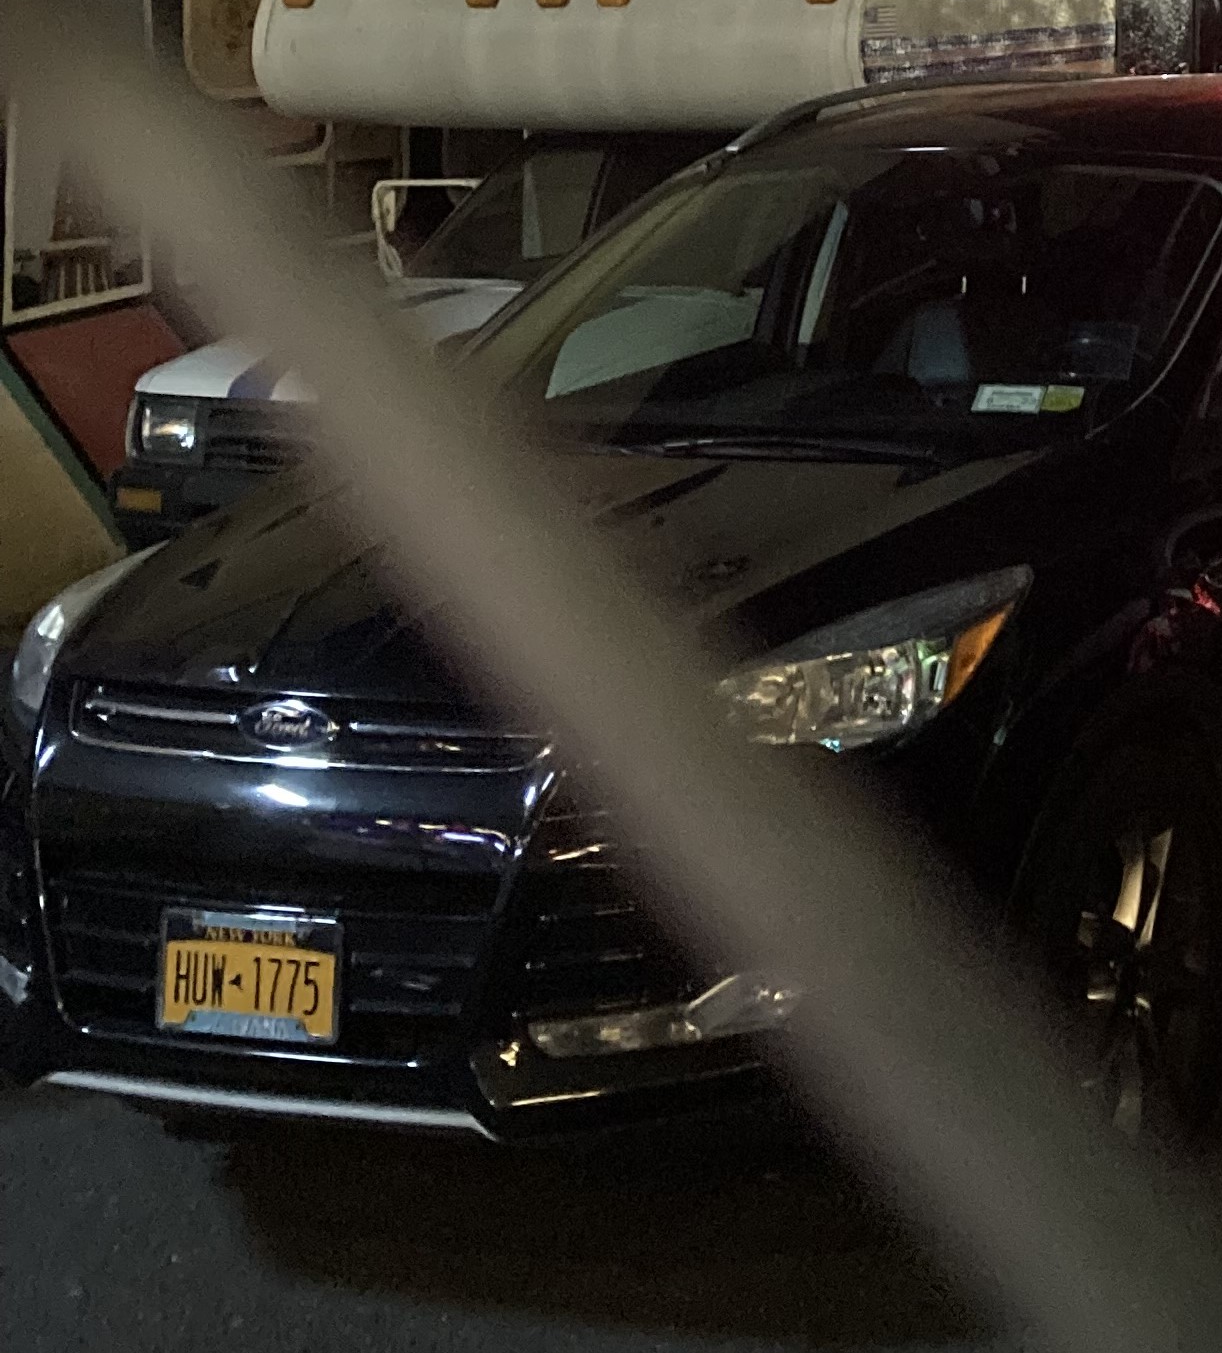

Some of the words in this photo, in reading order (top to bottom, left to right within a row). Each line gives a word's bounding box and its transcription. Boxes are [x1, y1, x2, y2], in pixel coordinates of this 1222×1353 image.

[254, 706, 312, 737] Ford
[204, 926, 245, 943] NEW
[252, 929, 298, 947] YORK
[253, 956, 321, 1016] 1775
